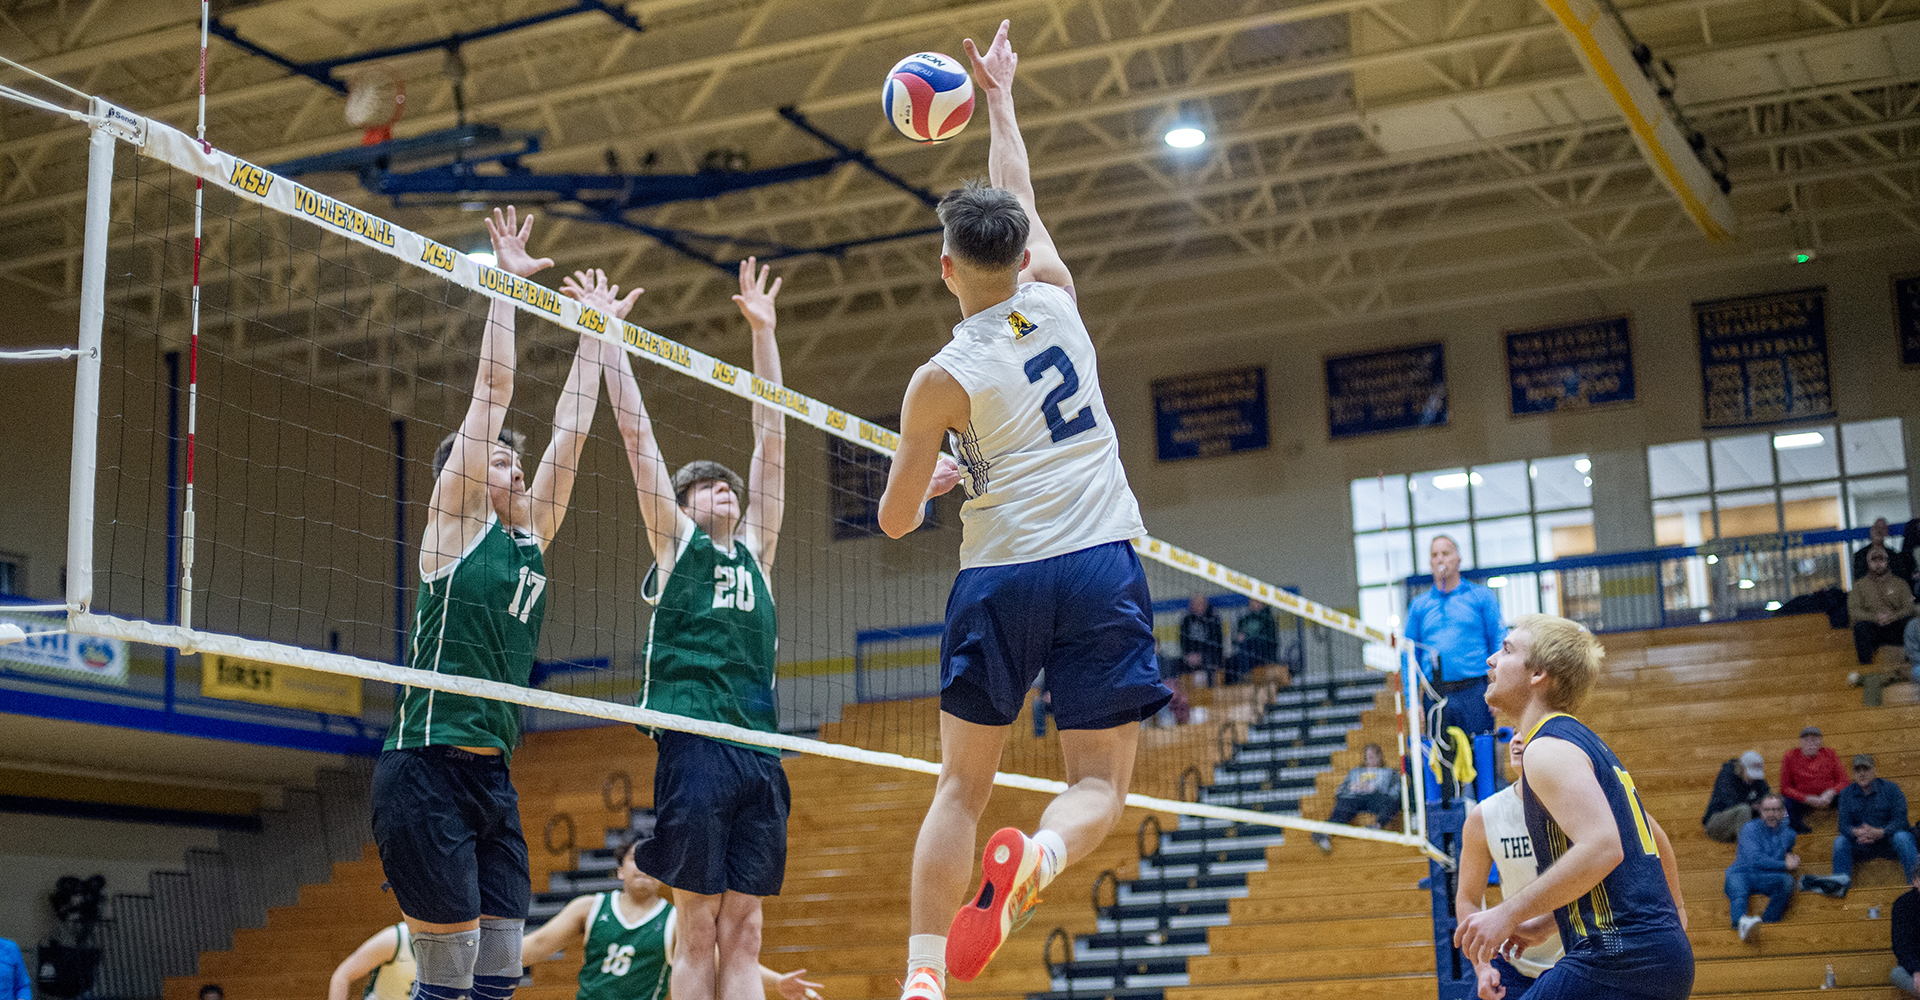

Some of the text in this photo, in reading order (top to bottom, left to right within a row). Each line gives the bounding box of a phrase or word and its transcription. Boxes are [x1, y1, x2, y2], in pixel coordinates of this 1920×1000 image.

[230, 159, 274, 197] MSJ
[294, 184, 394, 248] VOLLEYBALL
[421, 239, 457, 272] MSJ
[478, 264, 563, 316] VOLLEYBALL
[577, 303, 609, 334] MSJ
[621, 320, 691, 369] VOLLEYBALL
[712, 357, 738, 386] MSJ
[1023, 345, 1098, 444] 2
[508, 565, 547, 624] 17
[712, 564, 755, 612] 20
[1613, 765, 1660, 859] 1
[1500, 835, 1533, 859] THE
[601, 942, 636, 977] 16
